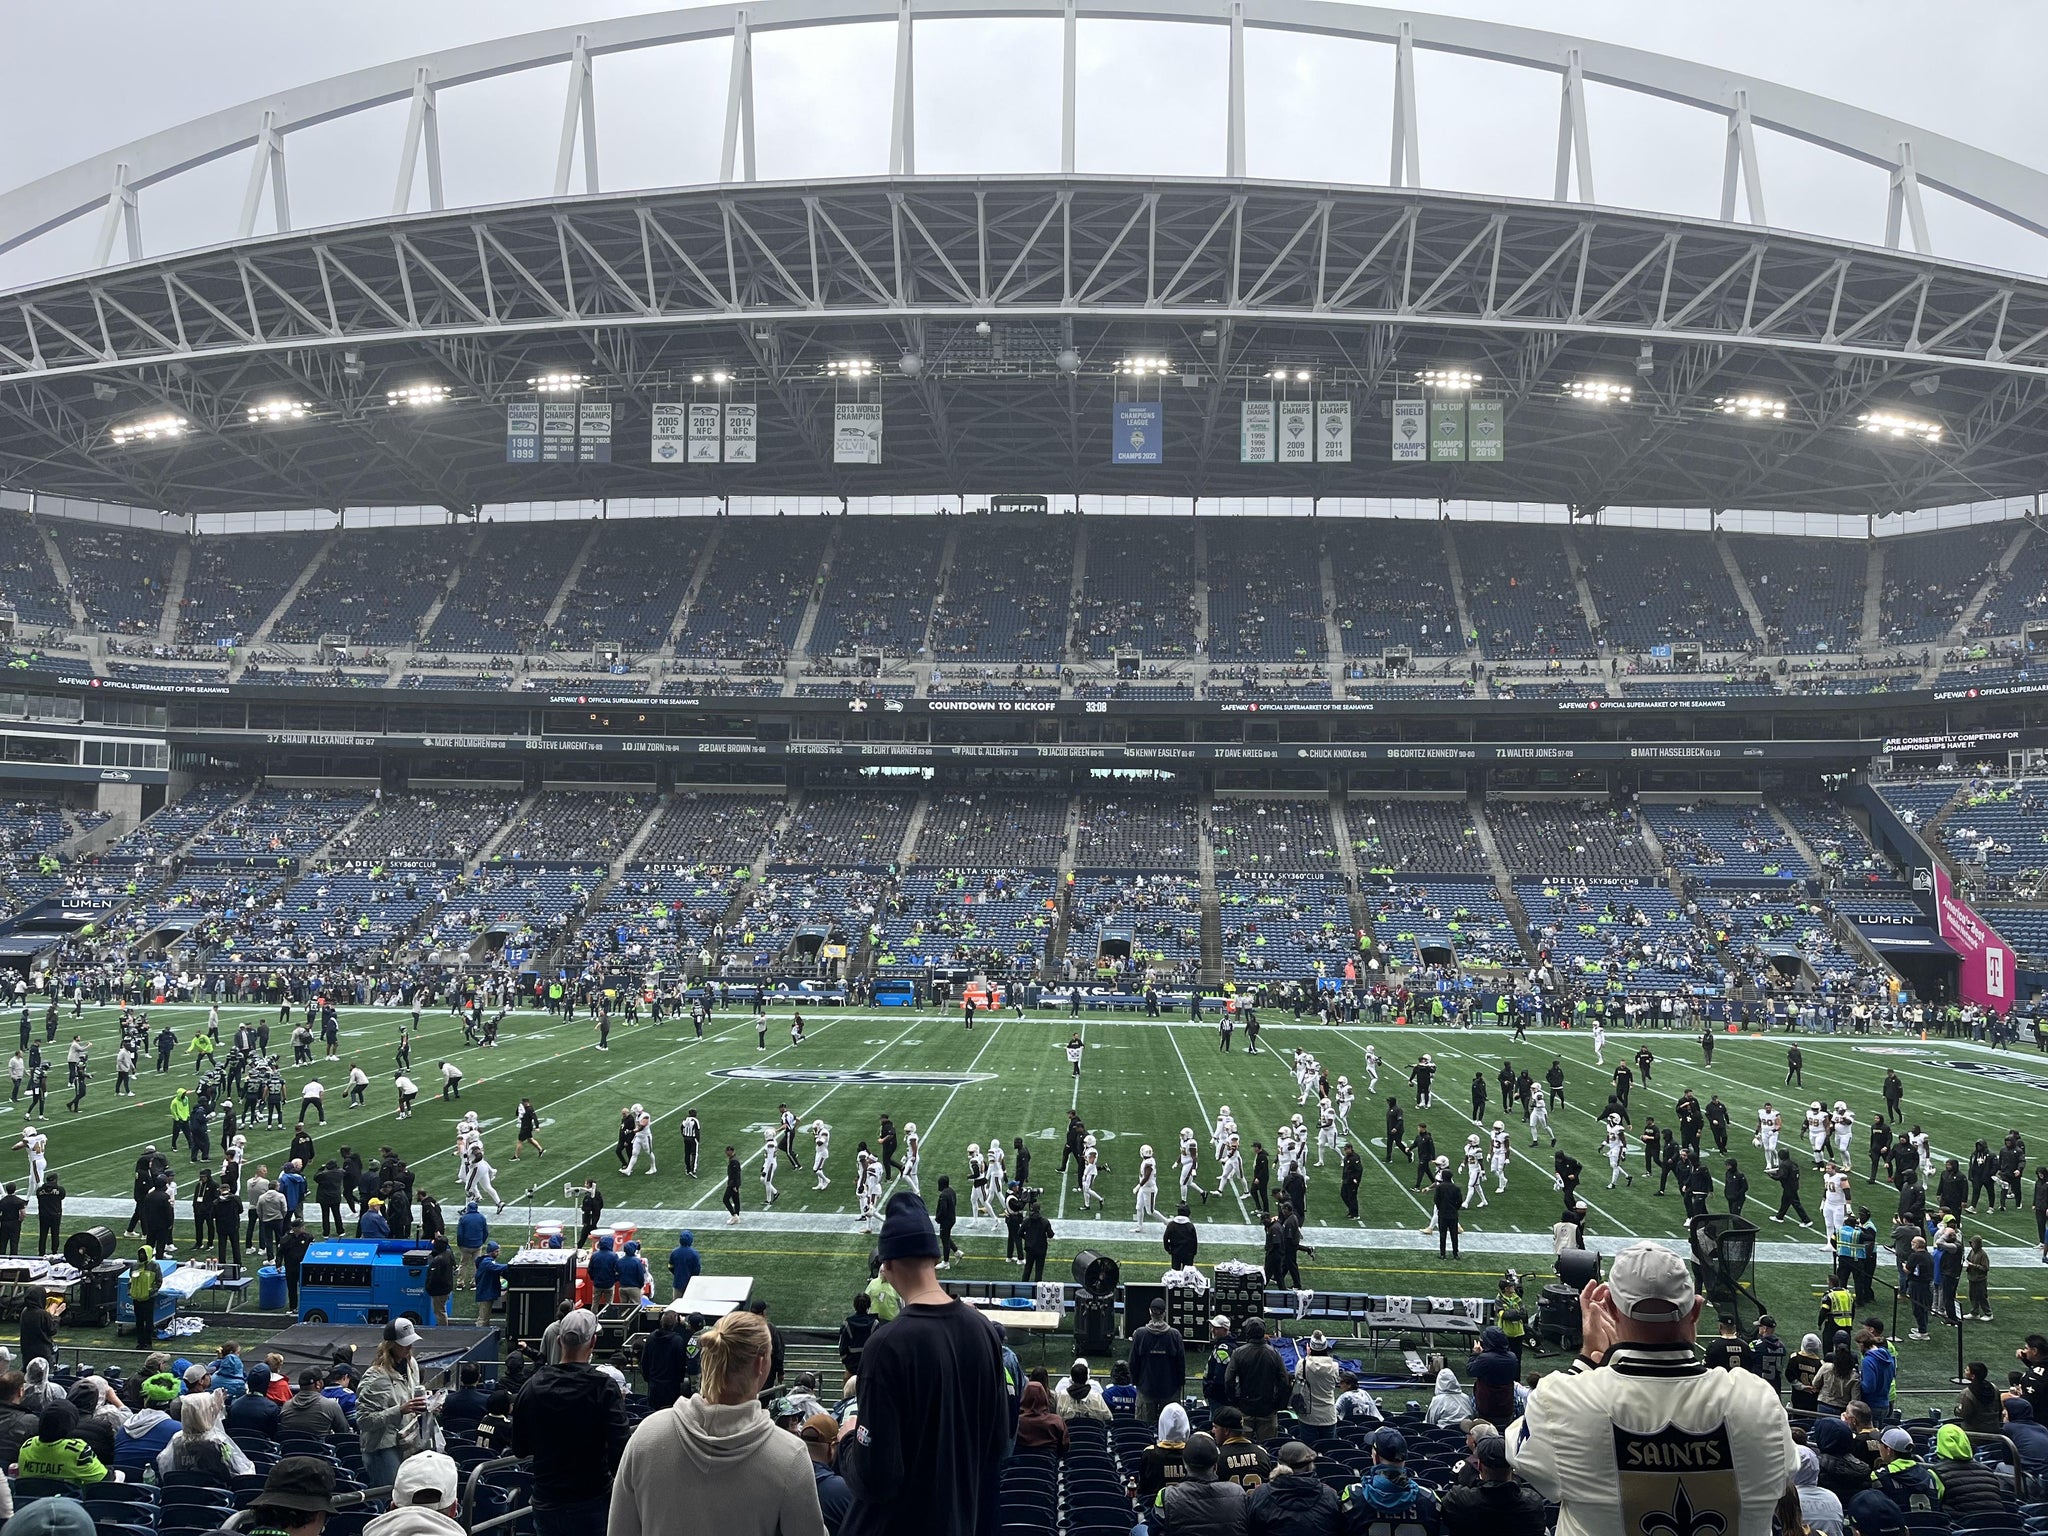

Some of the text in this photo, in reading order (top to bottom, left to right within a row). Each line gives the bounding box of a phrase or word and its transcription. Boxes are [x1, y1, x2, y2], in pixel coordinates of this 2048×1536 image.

[694, 418, 715, 427] 2013
[730, 418, 751, 427] 2014
[512, 439, 534, 447] 1988
[512, 450, 534, 458] 1999
[1438, 448, 1458, 456] 2016
[1476, 448, 1496, 456] 2019
[58, 677, 90, 686] SAFEWAY
[131, 683, 175, 692] SUPERMARKET
[1934, 687, 2009, 700] SAFEWAY OFFICIAL
[928, 702, 1056, 711] COUNTDOWN TO KICKOFF
[1086, 702, 1106, 712] 33:08
[282, 735, 308, 744] SHAUN
[310, 736, 353, 744] ALEXANDER
[1902, 736, 1956, 744] CONSISTENTLY
[1958, 733, 2001, 741] COMPETING
[454, 739, 490, 748] HOLMGREN
[539, 741, 558, 749] STEVE
[559, 742, 588, 750] LARGENT
[622, 742, 632, 750] 10
[647, 743, 664, 751] ZORN
[710, 744, 726, 752] DAVE
[728, 744, 751, 752] BROWN
[1886, 743, 1945, 752] CHAMPIONSHIPS
[873, 746, 890, 754] CURT
[962, 748, 977, 756] PAUL
[1158, 749, 1181, 757] EASLEY
[1225, 749, 1241, 757] DAVE
[1242, 749, 1263, 757] KRIEG
[1310, 750, 1352, 758] CHUCK KNOX
[1387, 749, 1458, 758] 96 CORTEZ KENNEDY
[1496, 749, 1506, 757] 71
[1507, 749, 1533, 757] WALTER
[1535, 749, 1556, 757] JONES
[1631, 748, 1637, 756] 8
[1638, 748, 1658, 756] MATT
[1660, 748, 1705, 756] HASSELBECK
[62, 900, 112, 908] LUMEN
[1859, 915, 1913, 924] LUMEN
[511, 950, 522, 959] 12
[1990, 956, 1999, 987] T
[1627, 1440, 1720, 1467] SAINTS
[1227, 1454, 1258, 1468] OLAVE
[24, 1460, 64, 1475] METCALF
[1164, 1465, 1185, 1477] HILL
